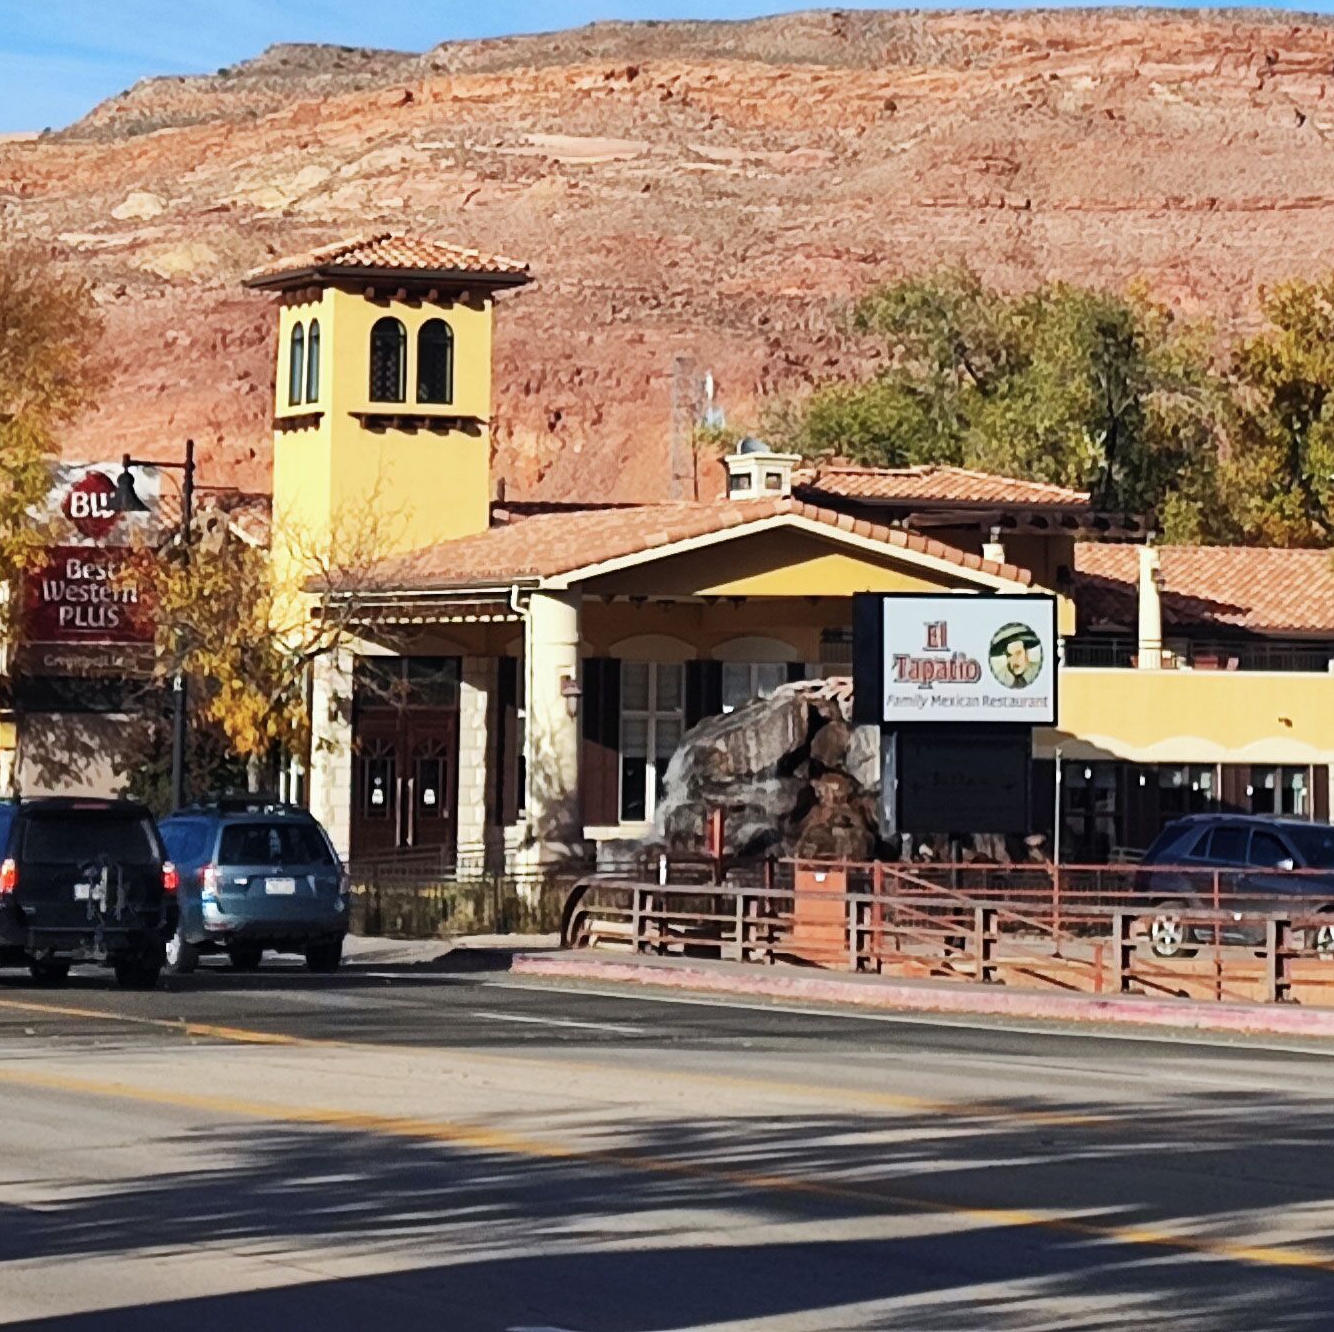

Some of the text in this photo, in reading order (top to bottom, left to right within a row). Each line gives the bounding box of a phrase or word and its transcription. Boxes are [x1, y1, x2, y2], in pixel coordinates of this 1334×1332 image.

[66, 559, 120, 580] Best
[42, 580, 137, 603] Western
[59, 606, 120, 627] PLUS
[923, 620, 950, 652] El
[887, 695, 1048, 710] Family Mexican Restaurant
